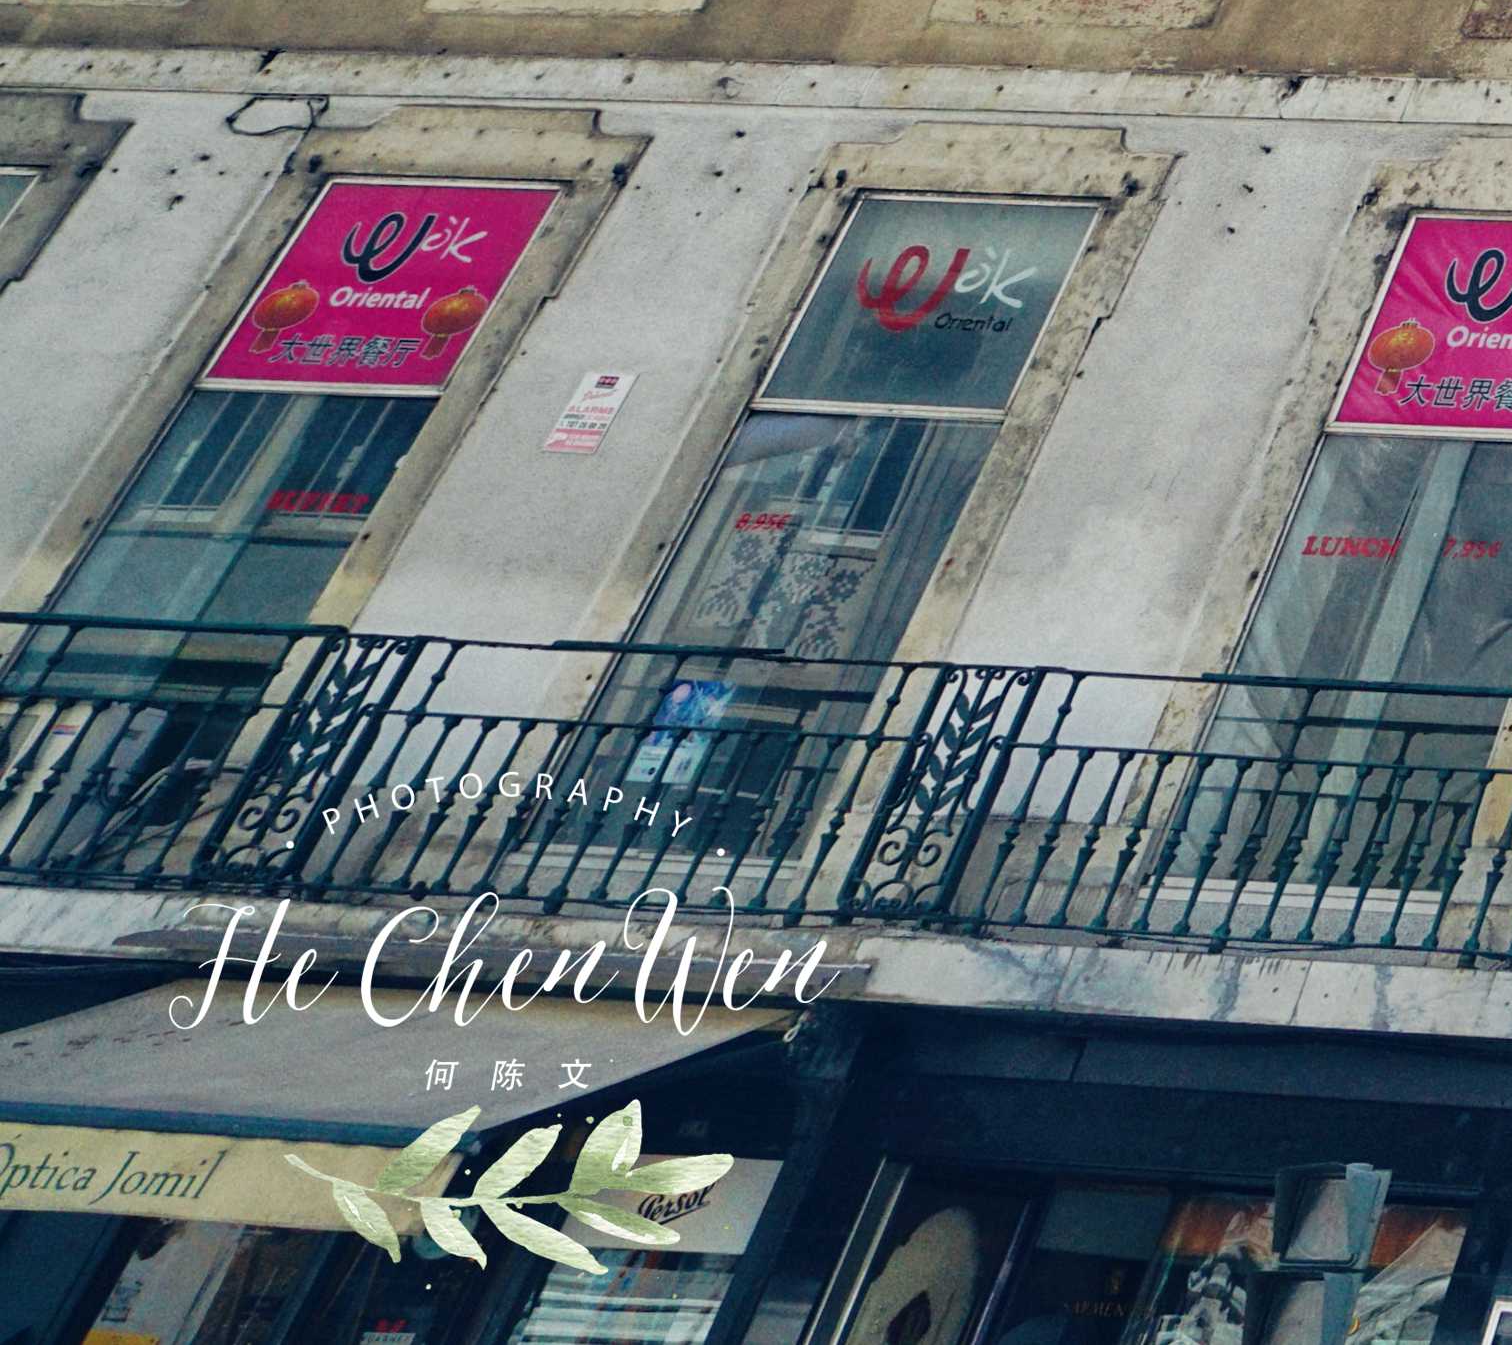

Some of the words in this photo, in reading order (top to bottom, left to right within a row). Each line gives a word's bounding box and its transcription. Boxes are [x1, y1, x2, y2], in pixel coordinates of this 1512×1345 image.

[329, 285, 432, 310] Oriental
[934, 312, 1014, 332] Oriental
[268, 332, 423, 369] 大世界餐厅
[1302, 535, 1402, 559] LUNCH
[88, 1149, 228, 1205] Jomil
